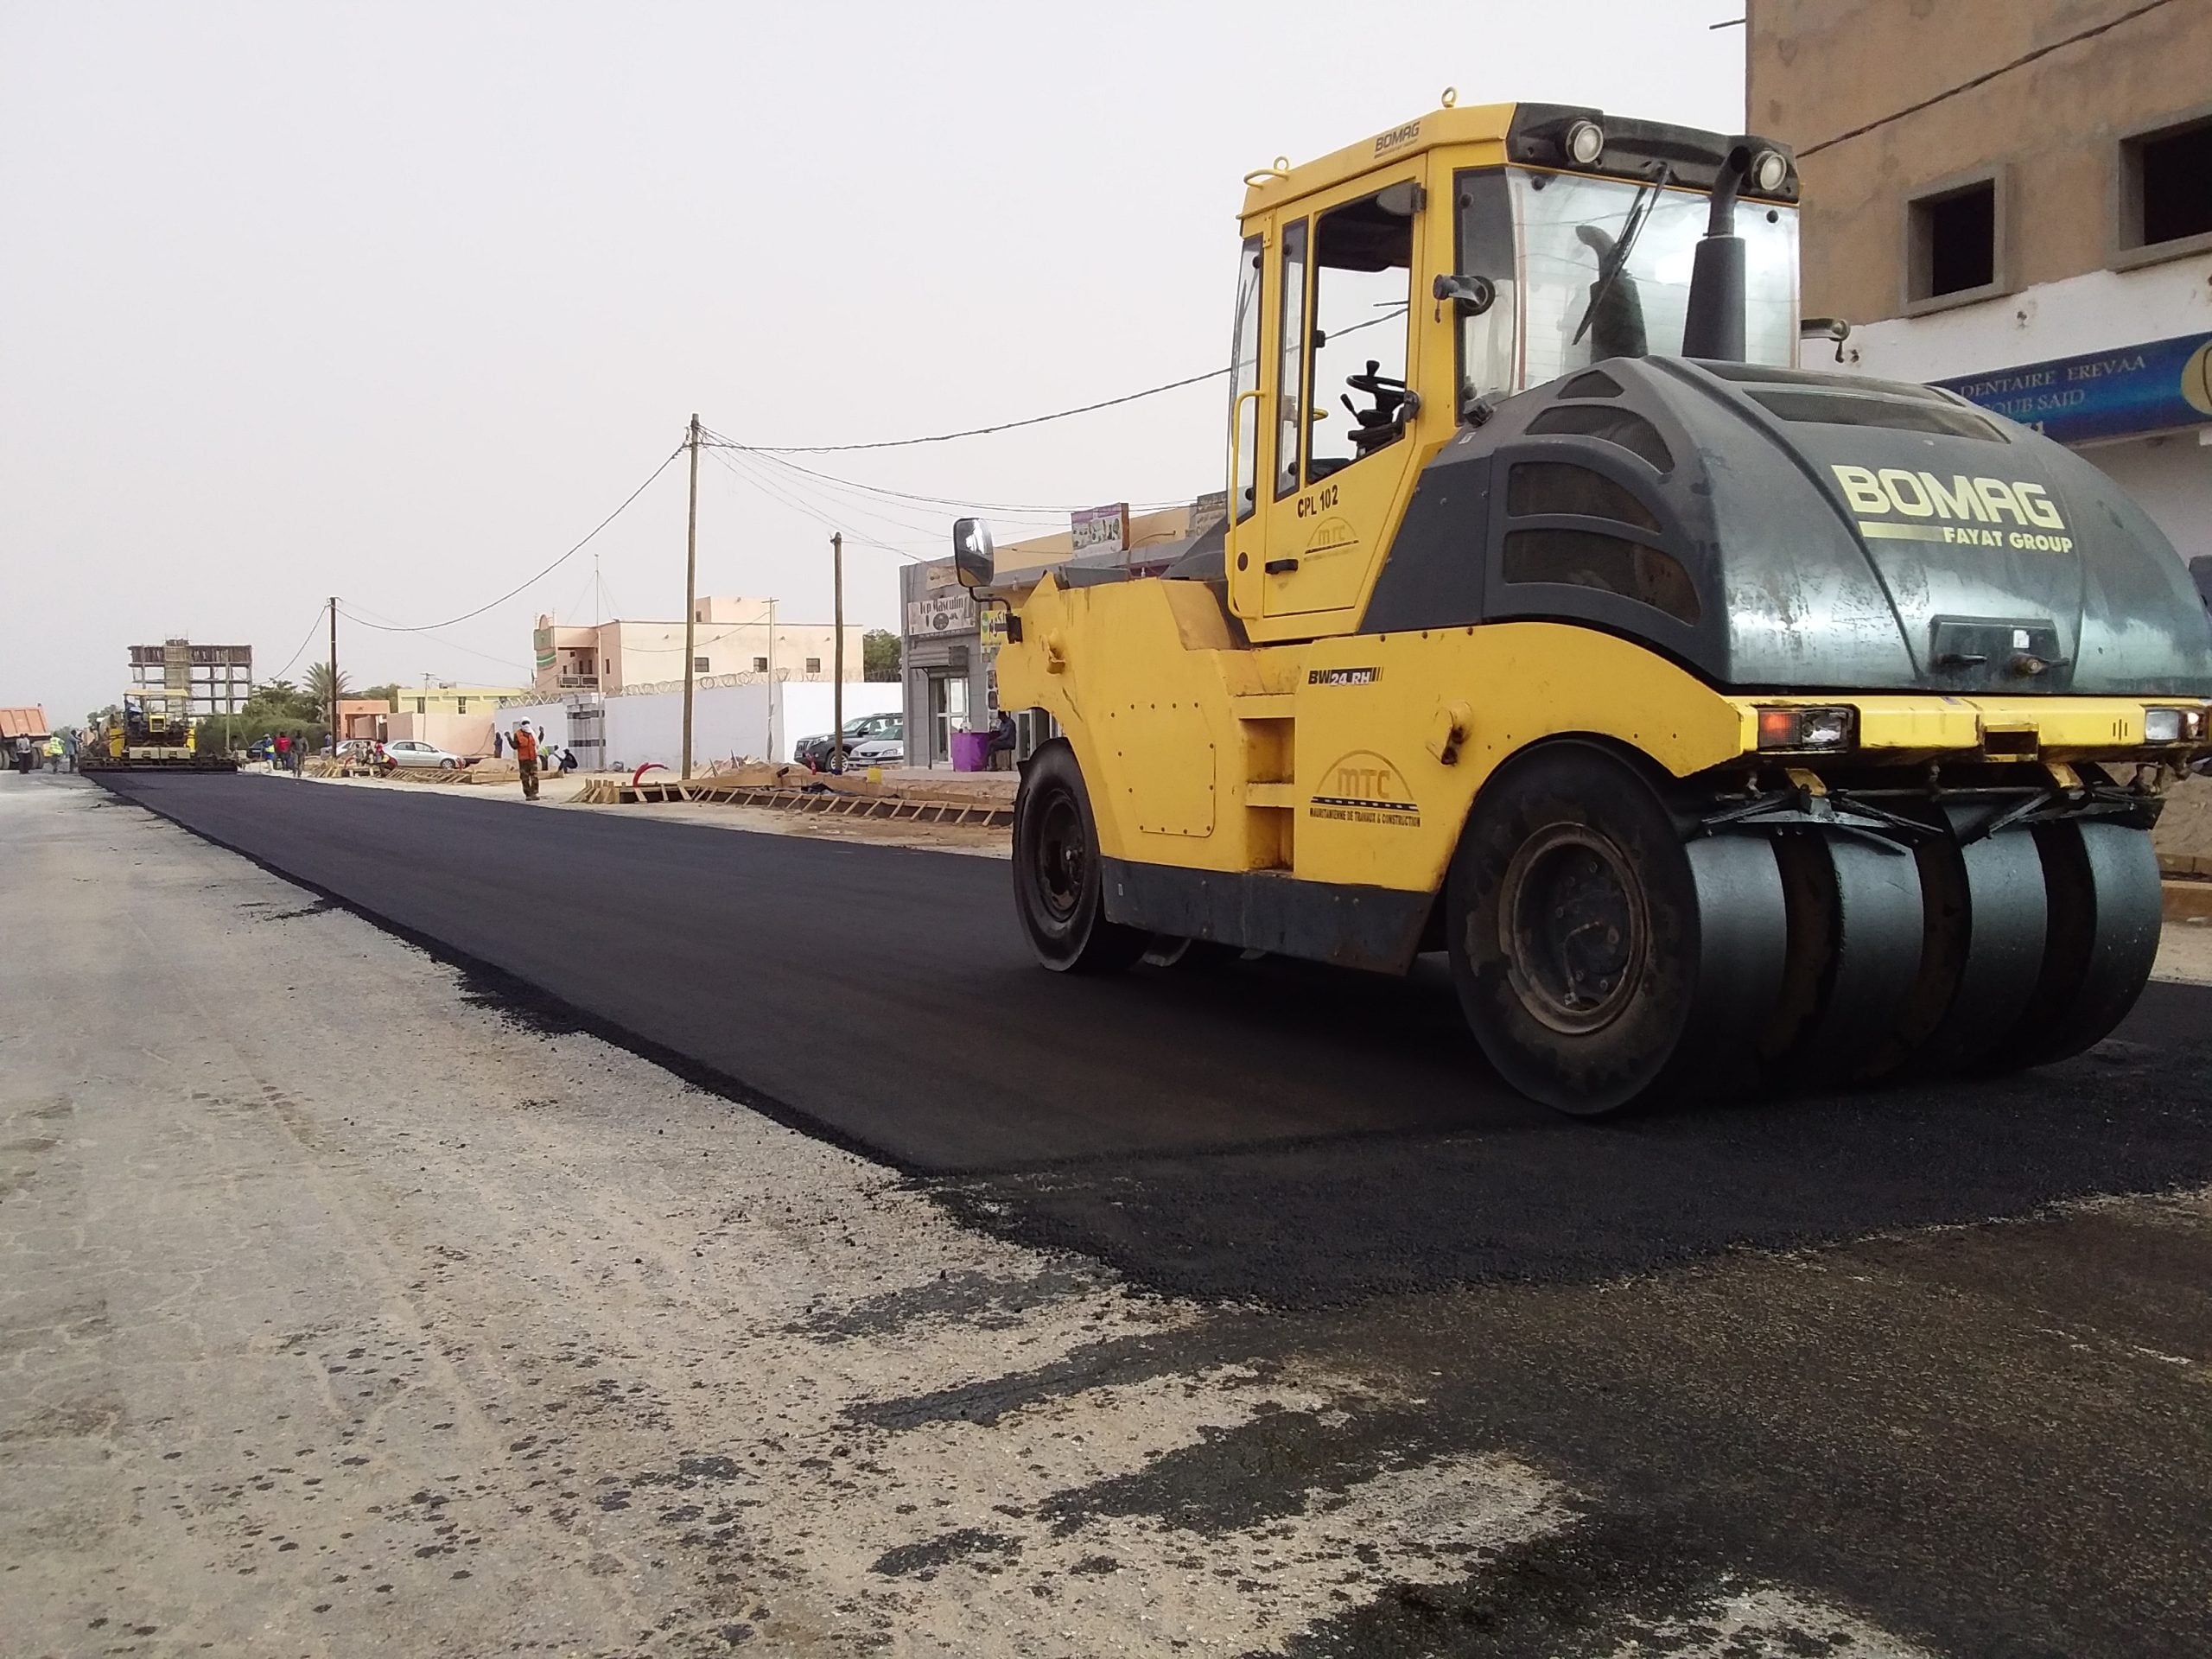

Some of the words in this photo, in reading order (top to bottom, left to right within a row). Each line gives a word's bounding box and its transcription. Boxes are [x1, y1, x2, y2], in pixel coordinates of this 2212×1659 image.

[1375, 121, 1421, 152] BOMAG
[1960, 370, 2057, 398] DENTAIRE
[2067, 354, 2147, 382] EREVAA
[2037, 389, 2086, 411] SAID
[1297, 495, 1318, 518] CPL
[1319, 484, 1338, 512] 102
[1830, 464, 2066, 530] BOMAG
[1942, 526, 2004, 547] FAYAT
[2009, 531, 2073, 553] GROUP
